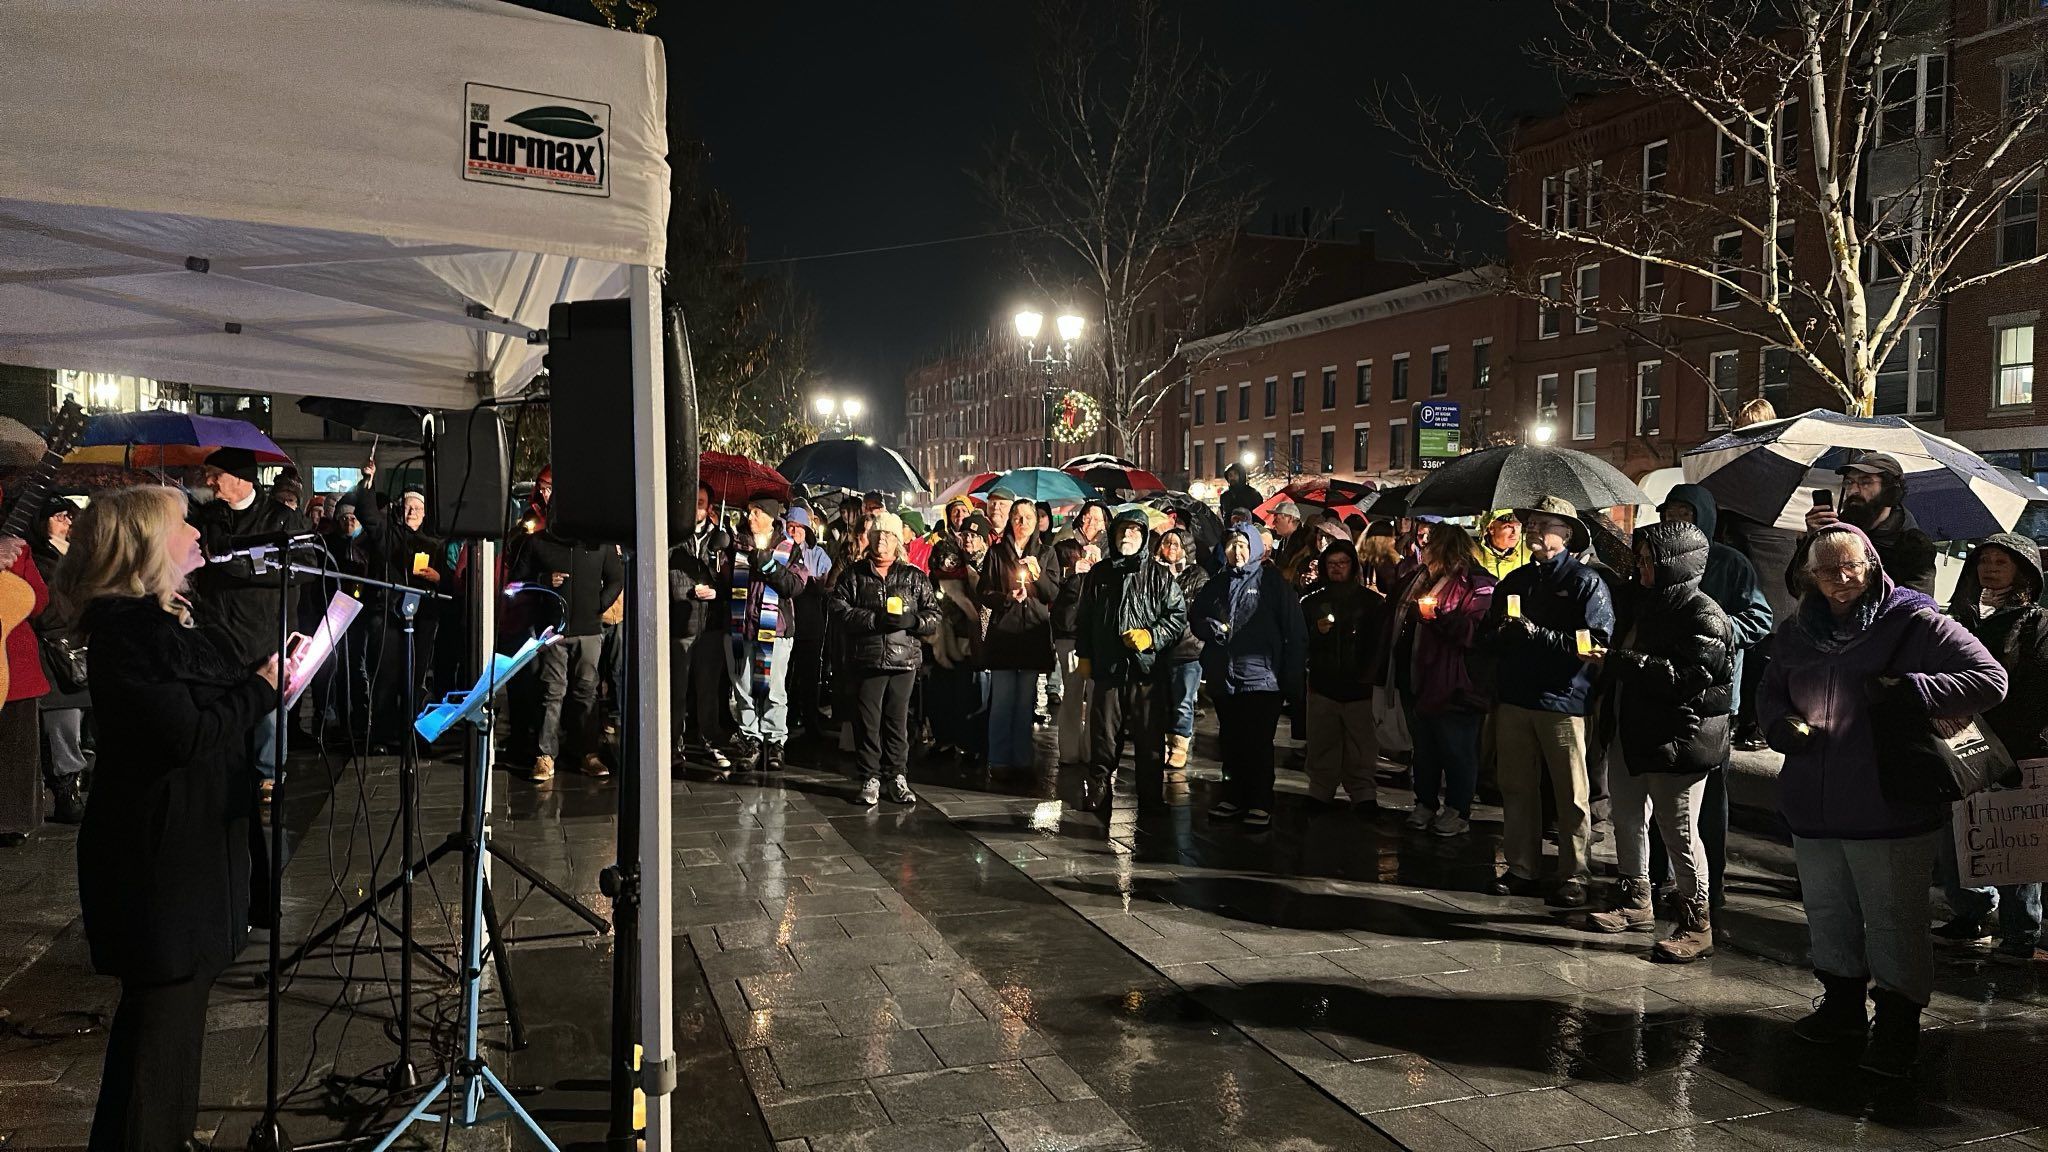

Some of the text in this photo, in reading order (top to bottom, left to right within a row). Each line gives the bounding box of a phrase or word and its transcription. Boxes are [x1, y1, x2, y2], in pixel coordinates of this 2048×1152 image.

[469, 122, 596, 175] Eurmax
[1425, 409, 1432, 420] P
[1968, 826, 2039, 850] Callous
[1970, 852, 2010, 877] Evil
